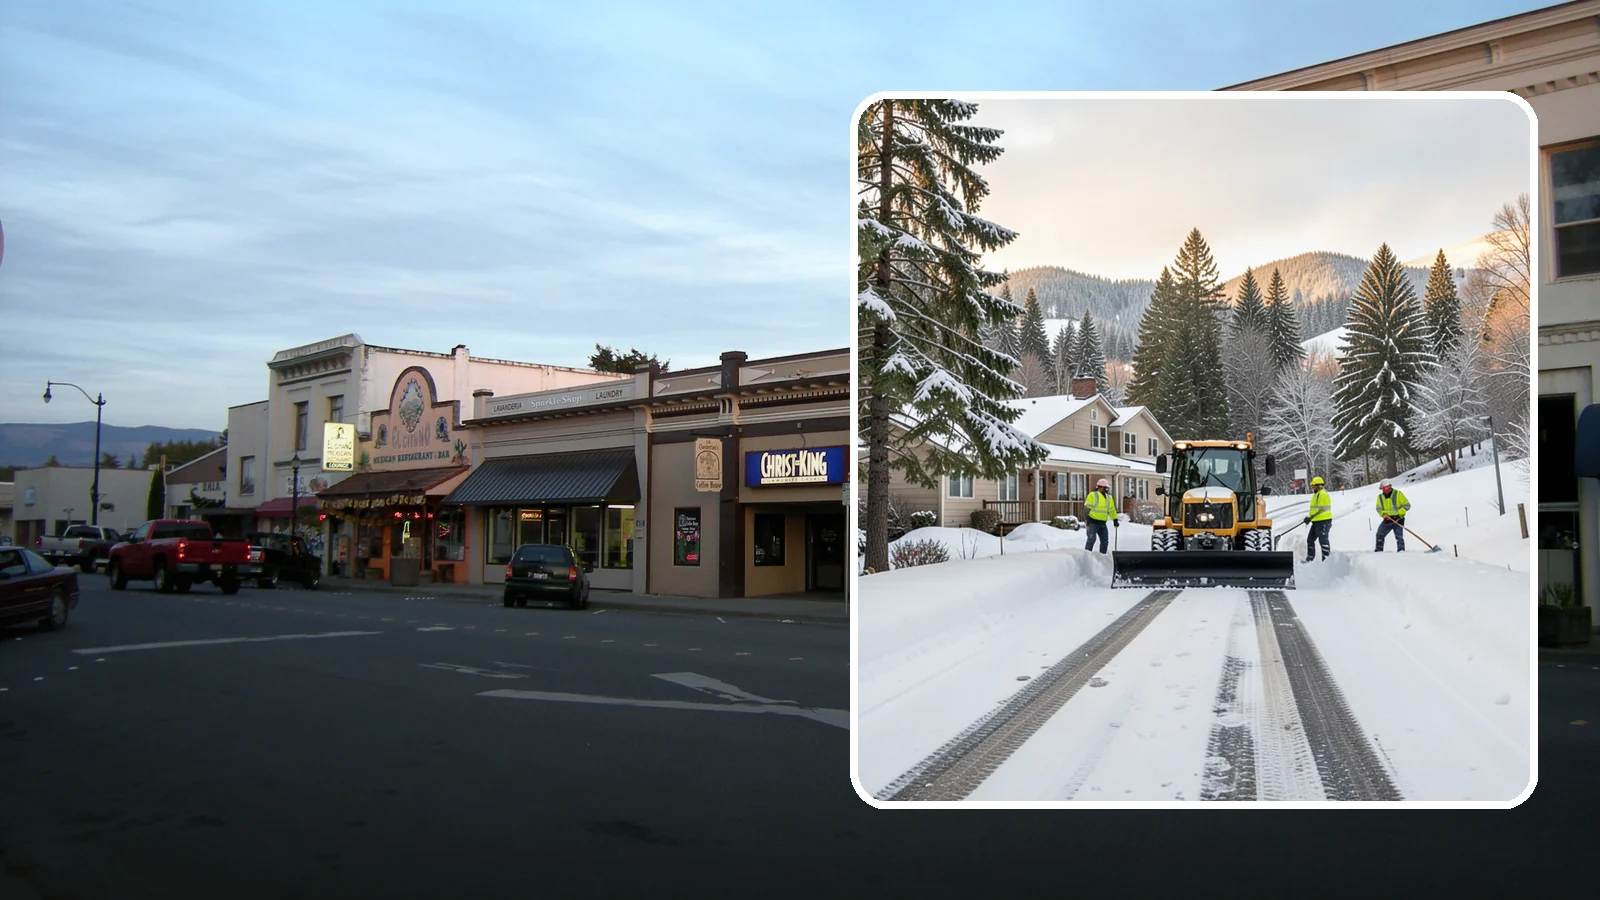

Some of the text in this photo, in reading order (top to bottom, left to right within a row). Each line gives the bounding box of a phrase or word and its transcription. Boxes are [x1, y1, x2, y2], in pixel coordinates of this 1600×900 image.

[595, 389, 624, 400] LAUNDRY
[493, 402, 523, 413] LAVANDERIA
[373, 455, 396, 465] MEXICAN
[397, 451, 434, 462] RESTAURANT
[437, 450, 450, 459] BAR
[760, 450, 827, 478] CHRIST KING
